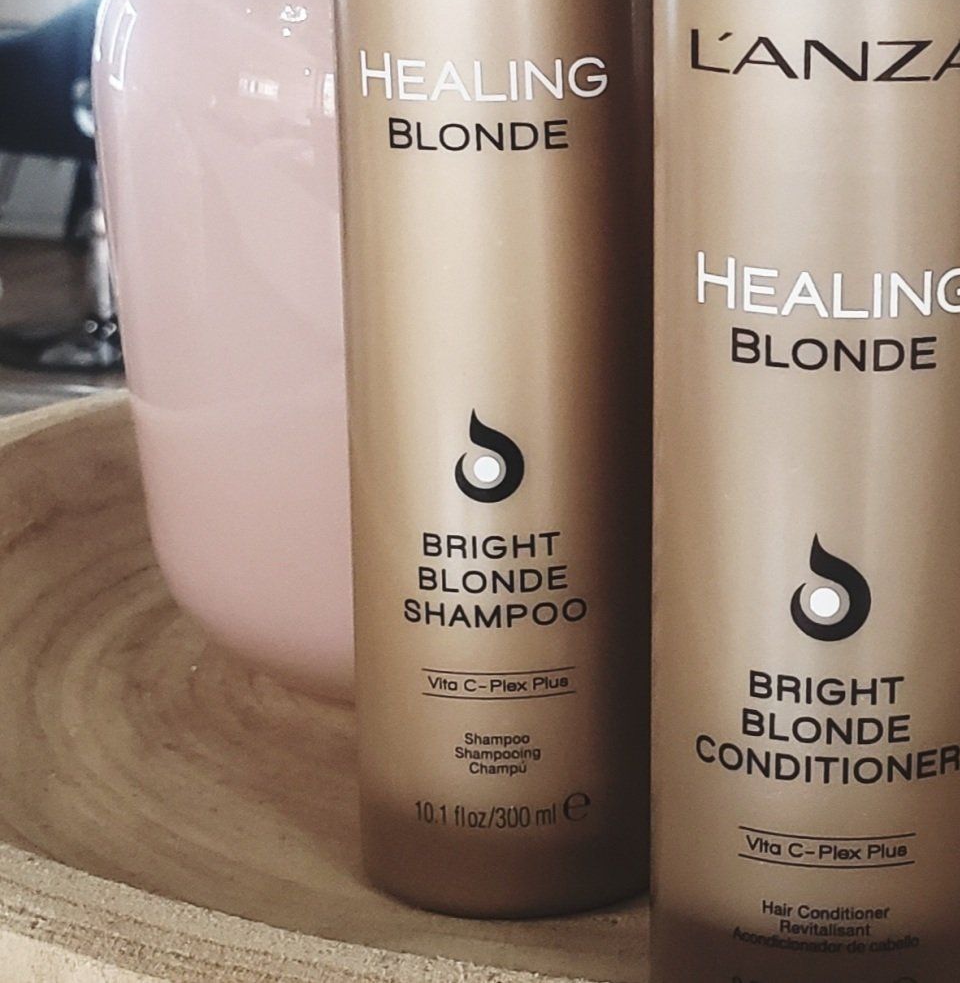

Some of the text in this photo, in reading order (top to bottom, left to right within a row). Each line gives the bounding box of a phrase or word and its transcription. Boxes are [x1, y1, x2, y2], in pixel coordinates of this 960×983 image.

[358, 48, 609, 104] HEALING
[387, 115, 571, 153] BLONDE
[731, 326, 938, 372] BLONDE
[421, 531, 561, 560] BRIGHT
[417, 564, 569, 595] BLONDE
[403, 597, 588, 628] SHAMPOO
[427, 675, 569, 693] Vita C-Plex Plus
[749, 670, 905, 706] BRIGHT
[464, 732, 530, 747] Shampoo
[741, 708, 912, 745] BLONDE
[454, 746, 541, 761] Shampooing
[468, 760, 527, 777] Champú
[415, 799, 448, 826] 10.1
[535, 802, 557, 825] ml
[746, 834, 908, 861] Vita C-Plex Plus
[762, 899, 891, 921] Hair Conditioner
[732, 925, 920, 954] Acondicionador de cabello
[779, 919, 872, 937] Revitalisant
